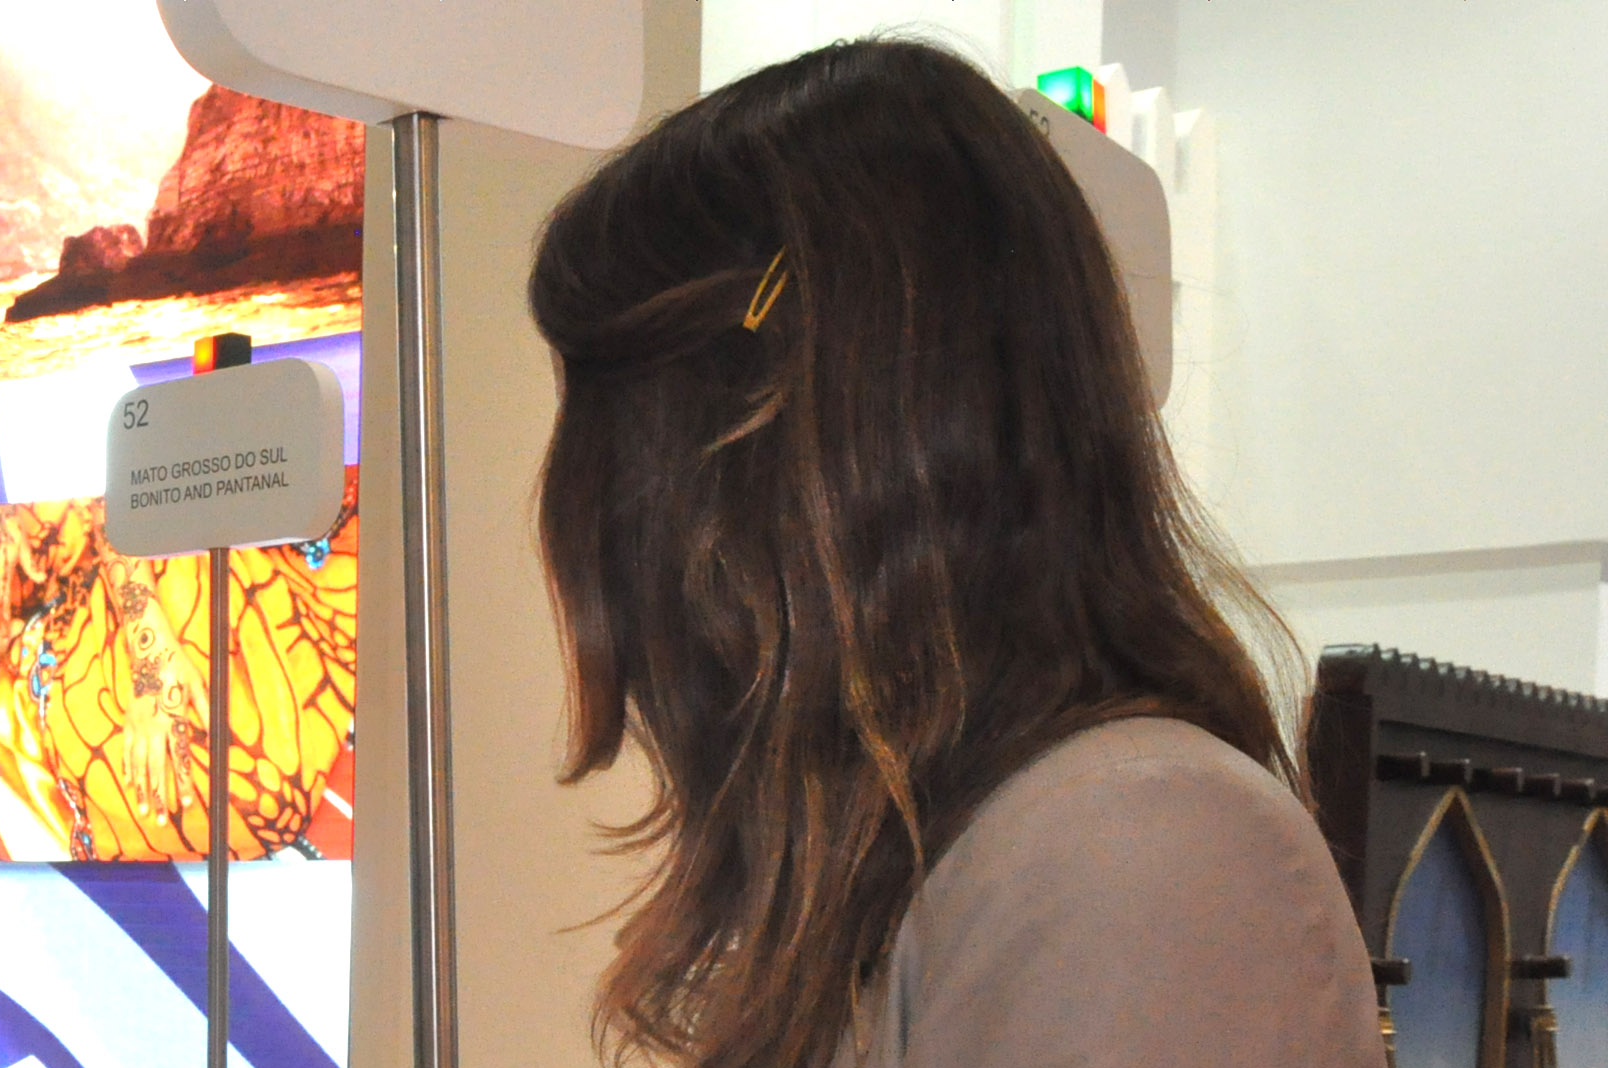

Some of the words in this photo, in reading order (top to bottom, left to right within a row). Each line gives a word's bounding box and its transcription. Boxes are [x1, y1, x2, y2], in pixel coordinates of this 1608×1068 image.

[123, 399, 150, 430] 52
[130, 466, 168, 487] MATO
[171, 455, 231, 480] GROSSO
[235, 451, 256, 470] DO
[259, 447, 288, 465] SUL
[130, 487, 181, 510] BONITO
[183, 482, 213, 501] AND
[216, 471, 289, 496] PANTANAL
